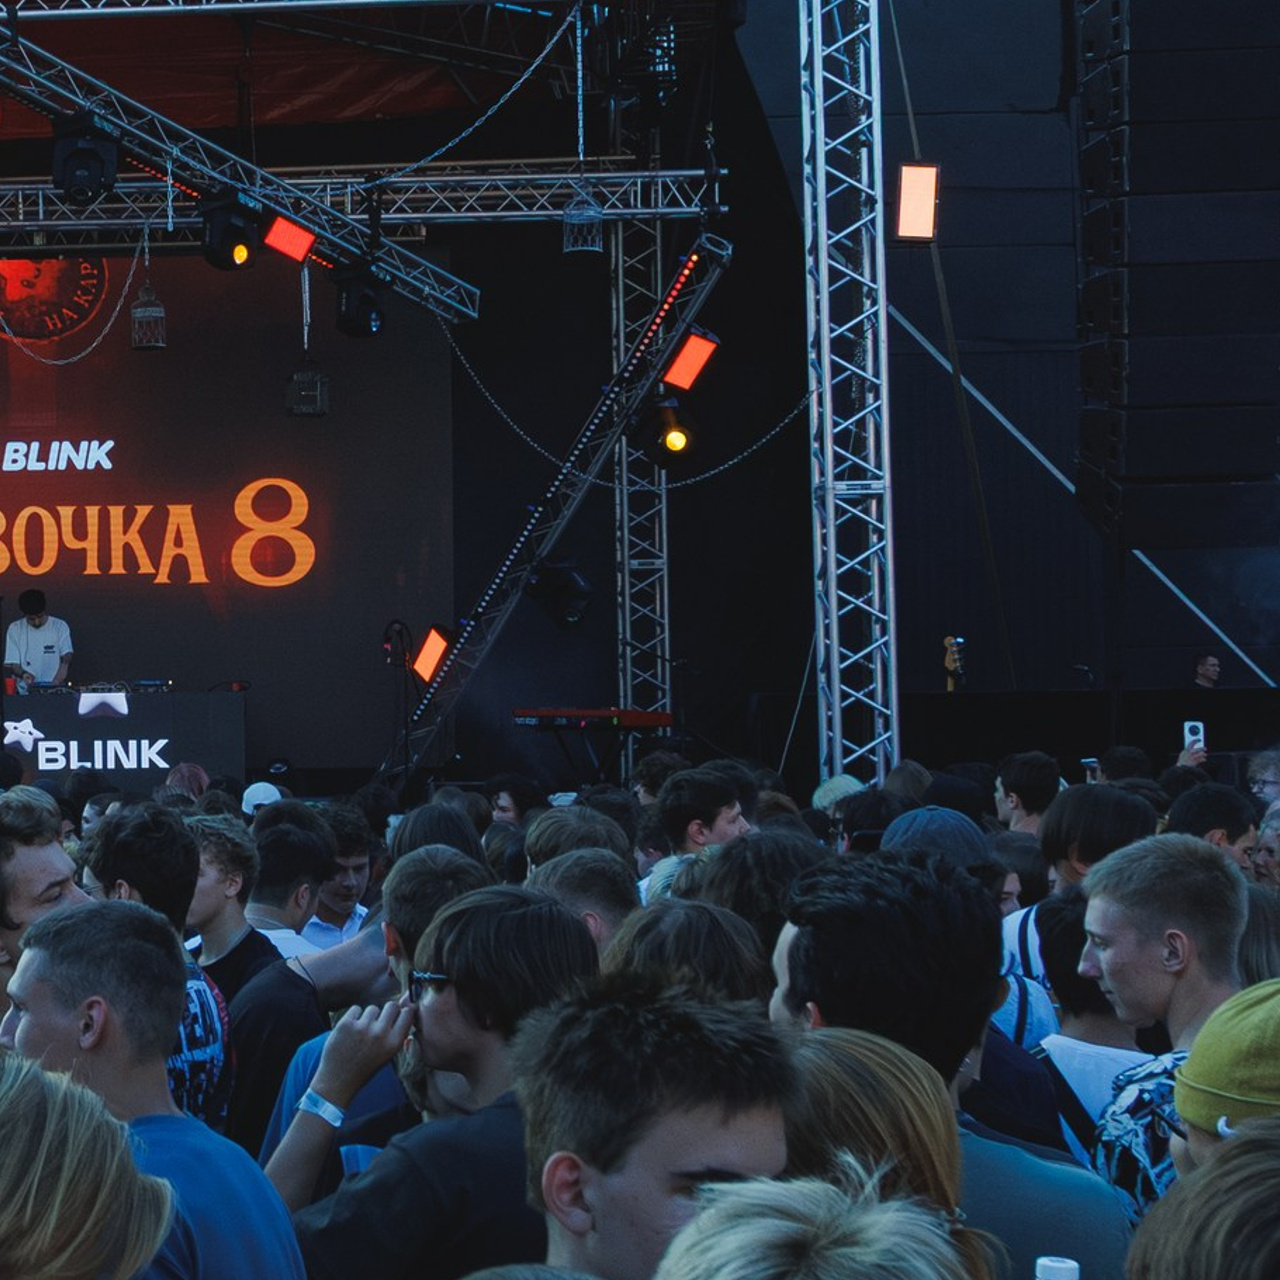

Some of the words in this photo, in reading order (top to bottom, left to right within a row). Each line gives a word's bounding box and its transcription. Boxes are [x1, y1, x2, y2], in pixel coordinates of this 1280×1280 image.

[44, 307, 79, 330] НА
[72, 258, 98, 307] КАР
[2, 440, 115, 471] BLINK
[231, 478, 316, 587] 8
[37, 738, 170, 770] BLINK
